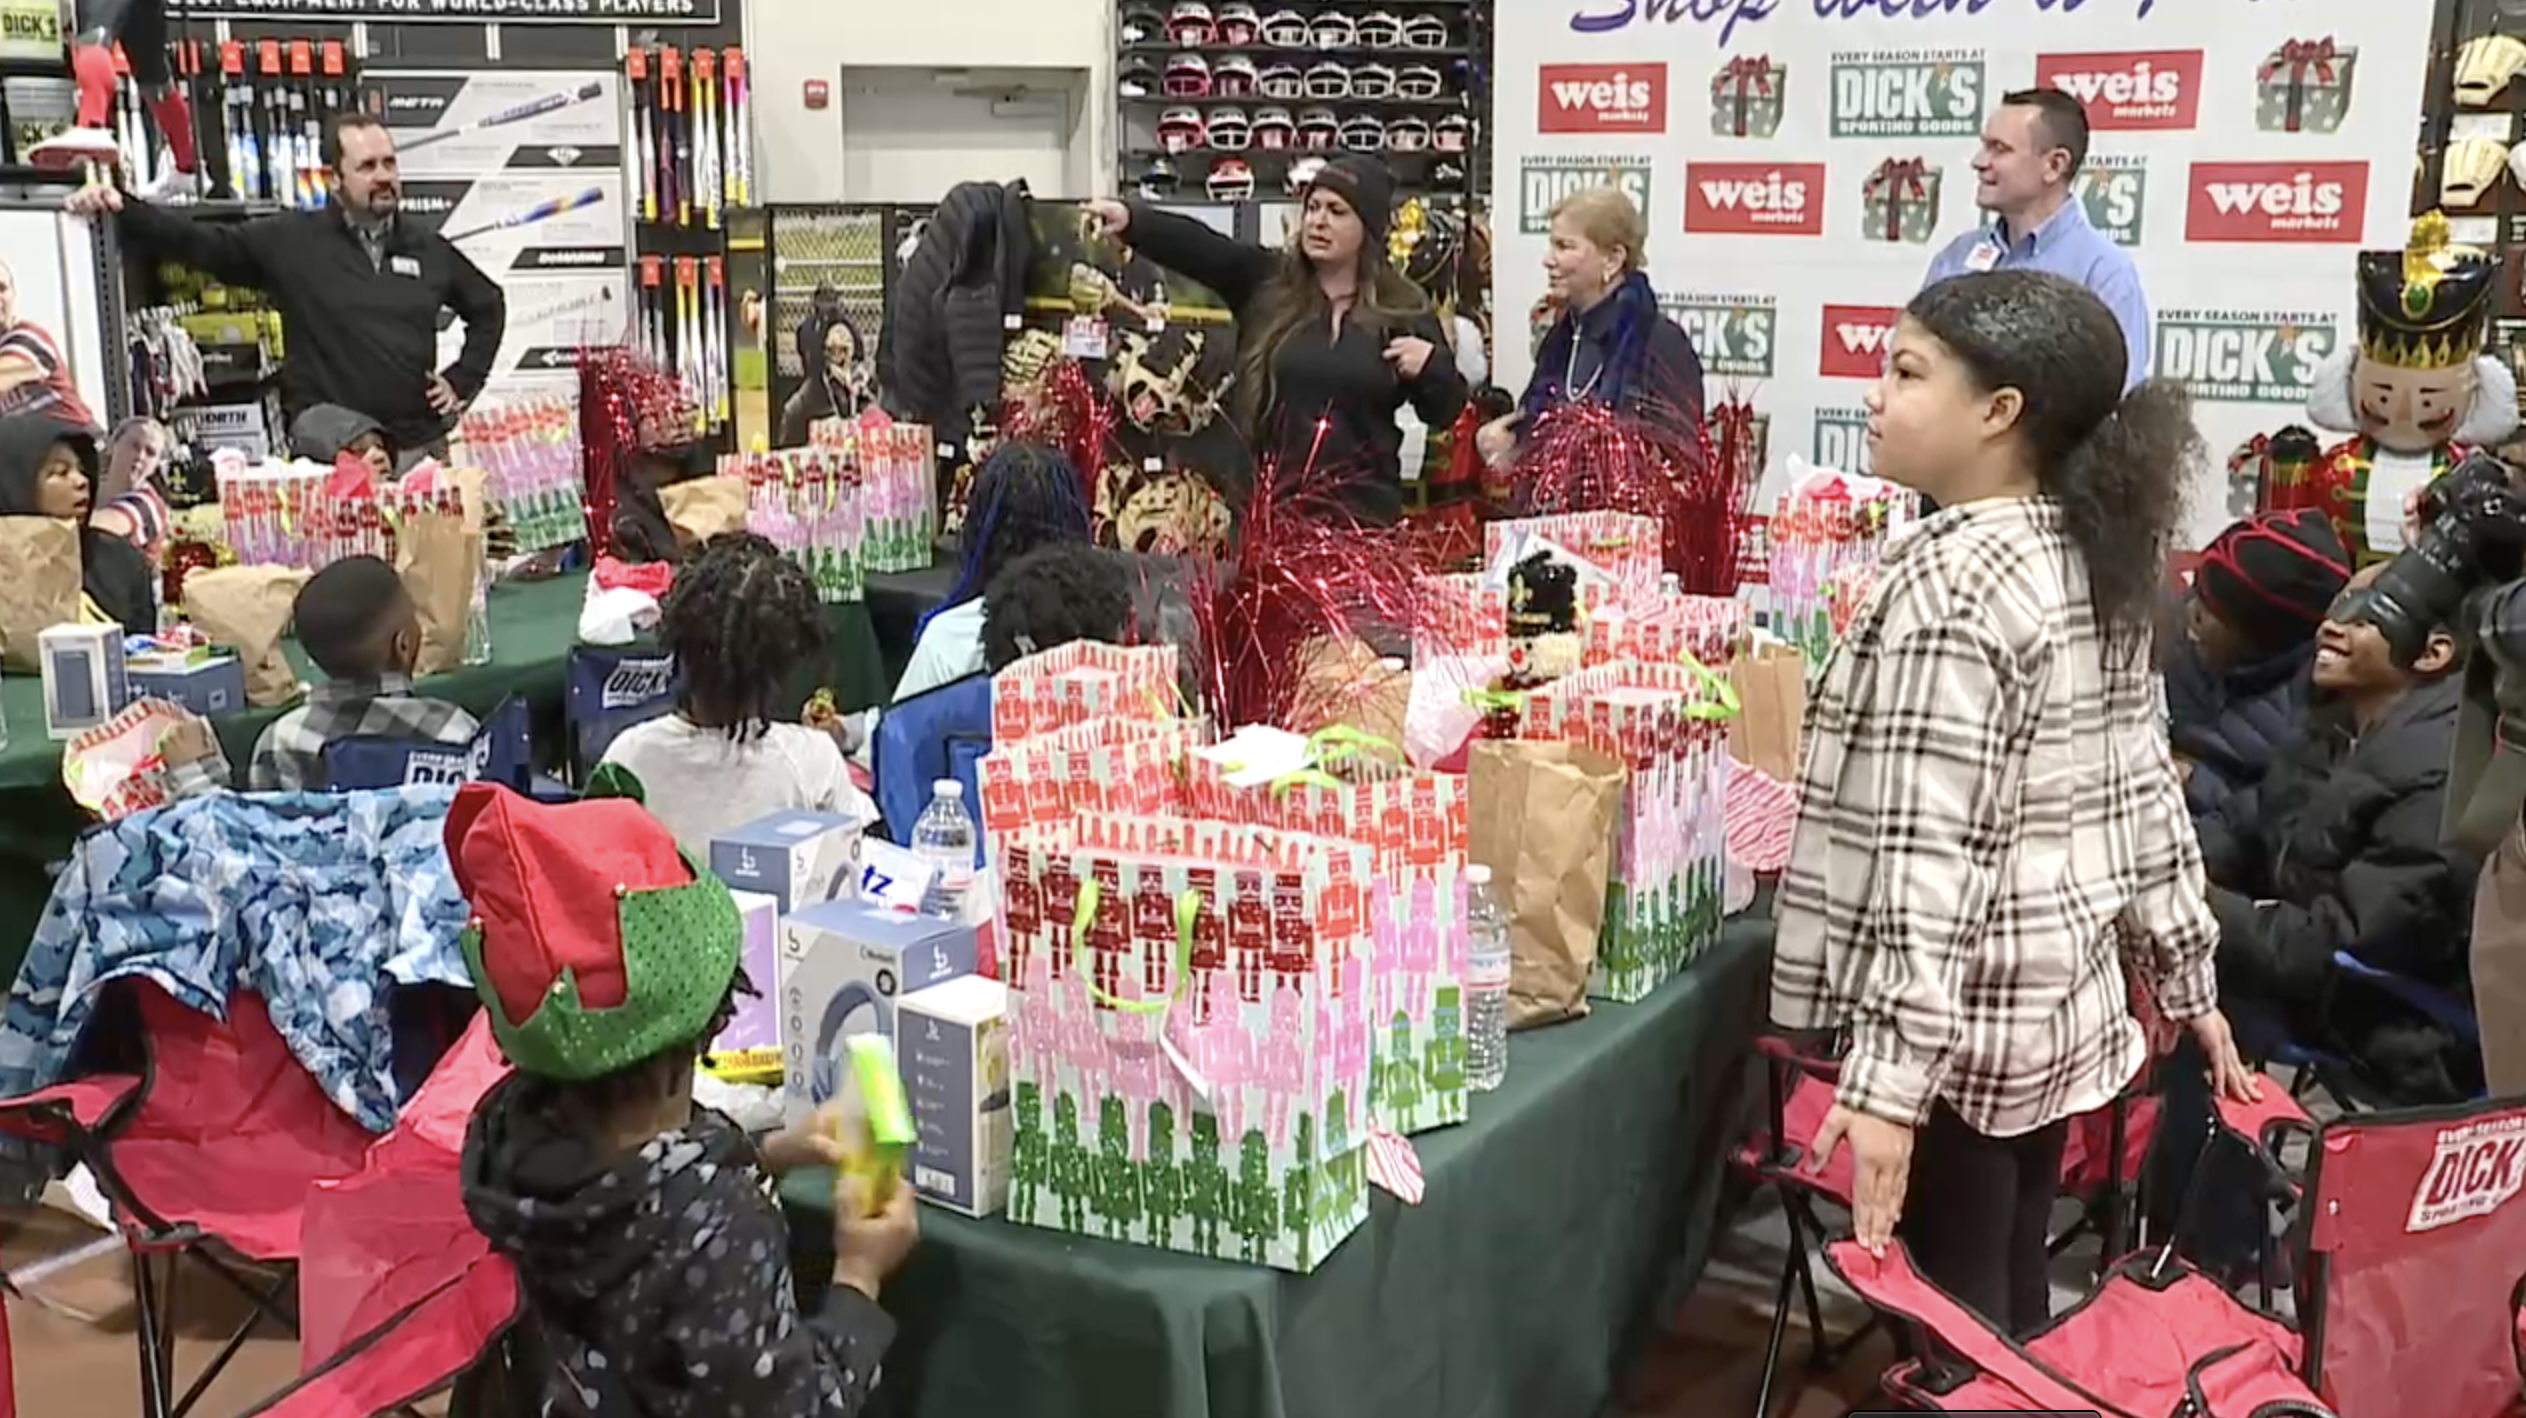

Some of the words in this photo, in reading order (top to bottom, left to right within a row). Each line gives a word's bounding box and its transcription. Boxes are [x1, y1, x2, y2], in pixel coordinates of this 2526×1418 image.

[600, 0, 694, 14] PLAYERS
[1832, 51, 1869, 62] EVERY
[1873, 50, 1920, 61] SEASON
[1923, 49, 1967, 61] STARTS
[1971, 48, 1986, 60] AT
[1550, 71, 1651, 110] weis
[1837, 66, 1977, 119] DICK'S
[2051, 61, 2179, 104] weis
[1838, 119, 1915, 134] SPORTING
[1918, 119, 1975, 134] GOODS
[1699, 169, 1806, 211] weis
[2205, 171, 2342, 216] weis
[2157, 308, 2200, 320] EVERY
[2205, 310, 2260, 322] SEASON
[2263, 311, 2316, 323] STARTS
[2319, 312, 2338, 323] AT
[2162, 327, 2327, 385] DICK'S
[1815, 406, 1853, 418] EVERY
